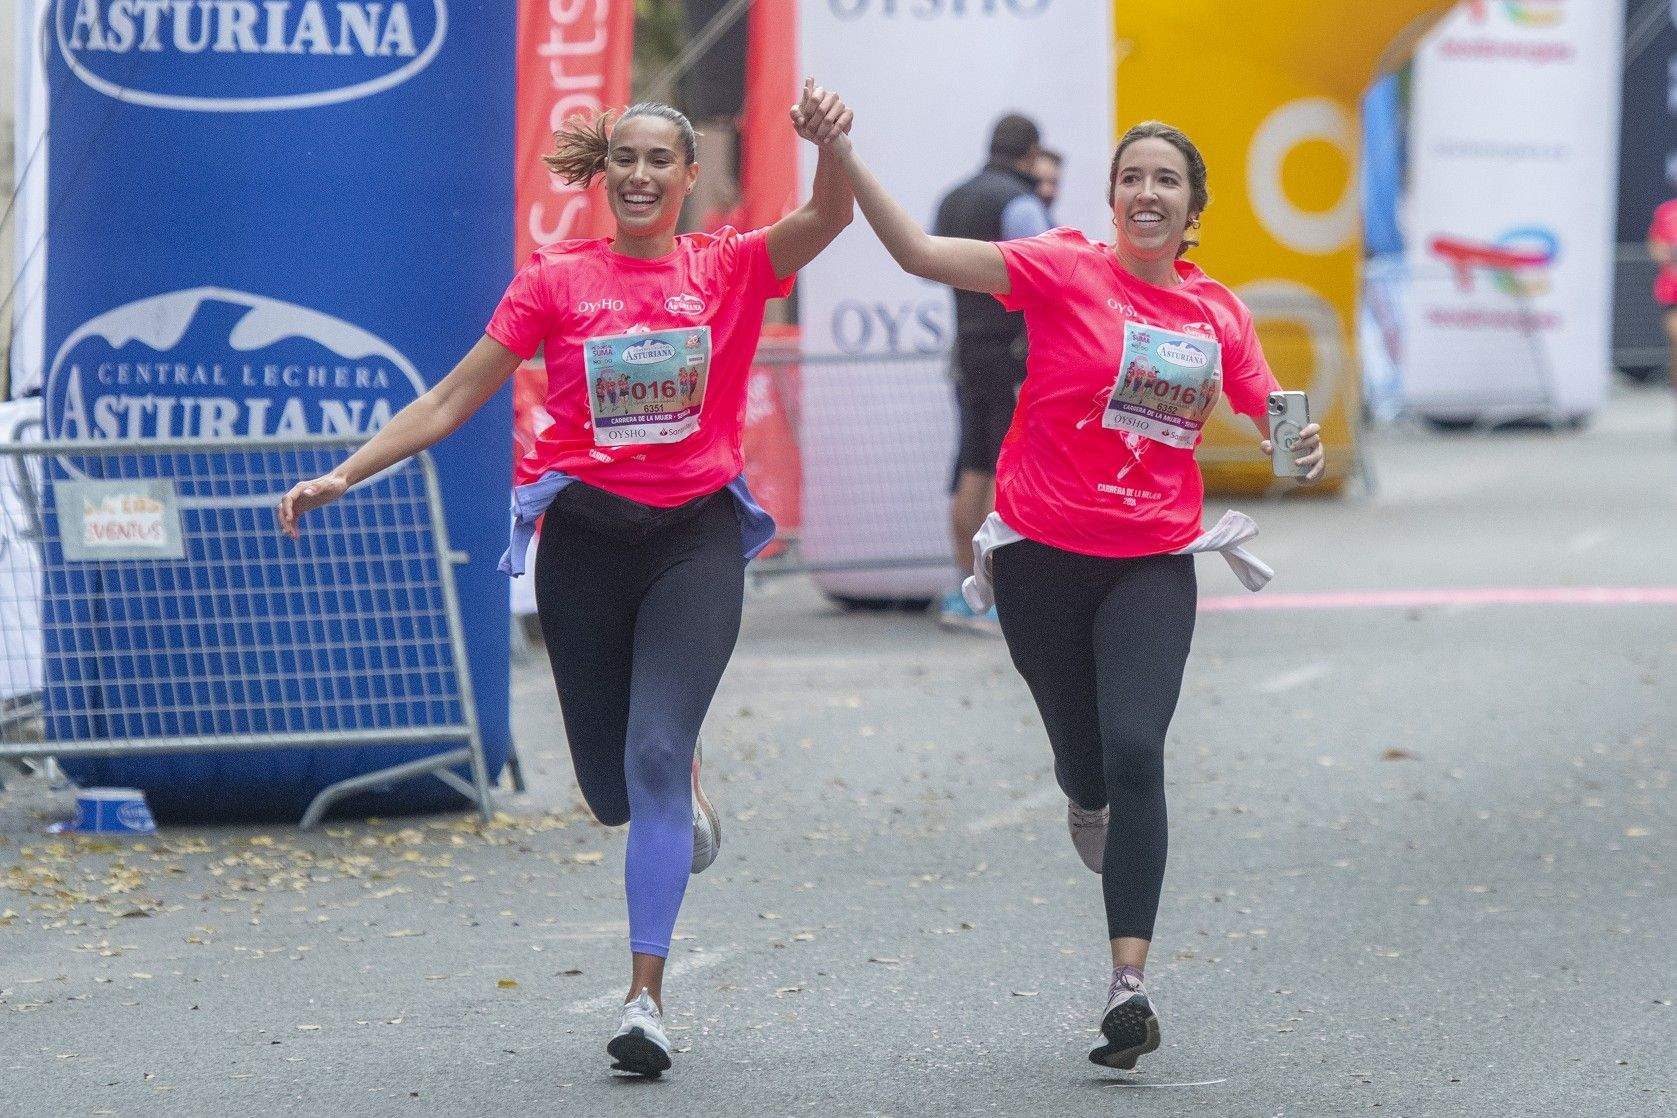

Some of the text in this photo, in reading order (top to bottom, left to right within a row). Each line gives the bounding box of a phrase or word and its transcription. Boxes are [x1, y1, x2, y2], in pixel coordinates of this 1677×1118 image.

[66, 0, 417, 57] ASTURIANA
[831, 299, 946, 355] OYS
[626, 349, 673, 361] ASTURIANA
[1160, 346, 1204, 365] ASTURIANA
[97, 363, 391, 389] CENTRAL LECHERA
[631, 379, 677, 401] 016
[1153, 379, 1197, 405] 016
[643, 403, 664, 413] 6351
[1122, 404, 1147, 414] CARRERA
[1147, 409, 1155, 417] DE
[1155, 411, 1163, 419] LA
[1157, 402, 1178, 415] 6352
[611, 416, 637, 425] CARRERA
[655, 413, 673, 422] MUJER
[1114, 413, 1150, 431] OYSHO
[608, 428, 647, 440] OYSHO
[1097, 483, 1126, 496] CARRERA
[1126, 488, 1135, 497] DE
